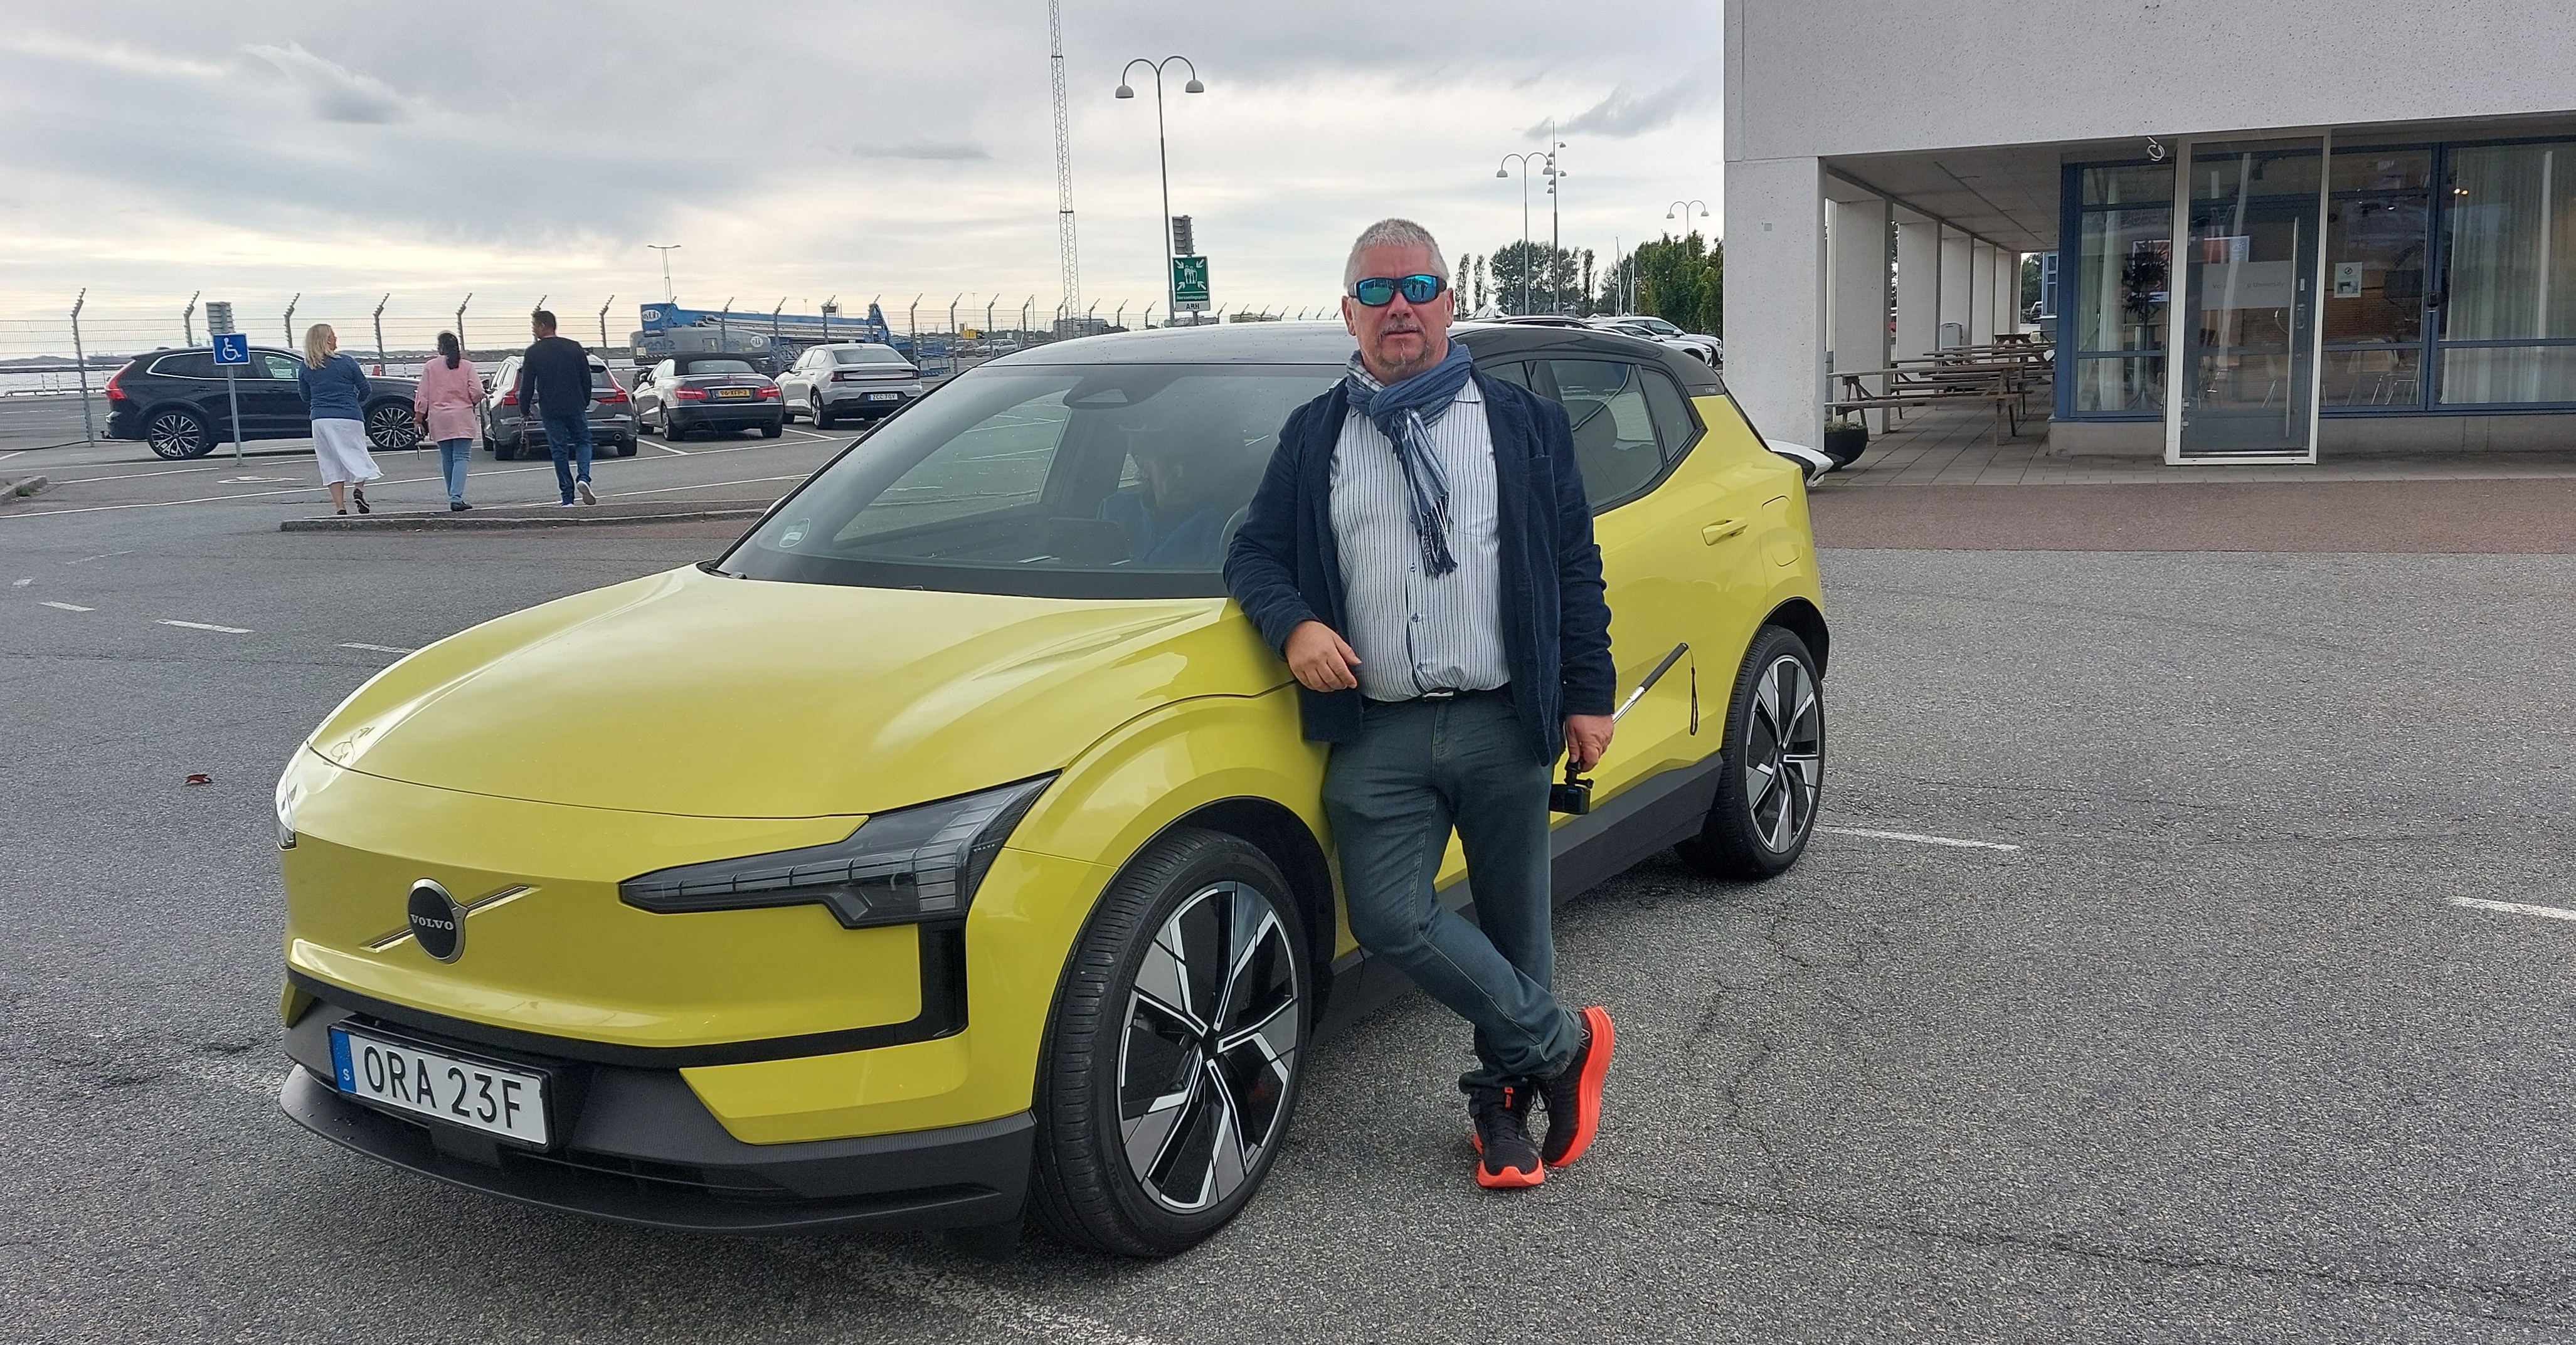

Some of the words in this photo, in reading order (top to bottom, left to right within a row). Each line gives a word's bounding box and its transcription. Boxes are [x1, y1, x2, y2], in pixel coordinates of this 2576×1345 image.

[410, 914, 454, 931] VOLVO
[342, 1068, 350, 1081] S
[364, 1045, 438, 1109] ORA
[447, 1065, 522, 1129] 23F
